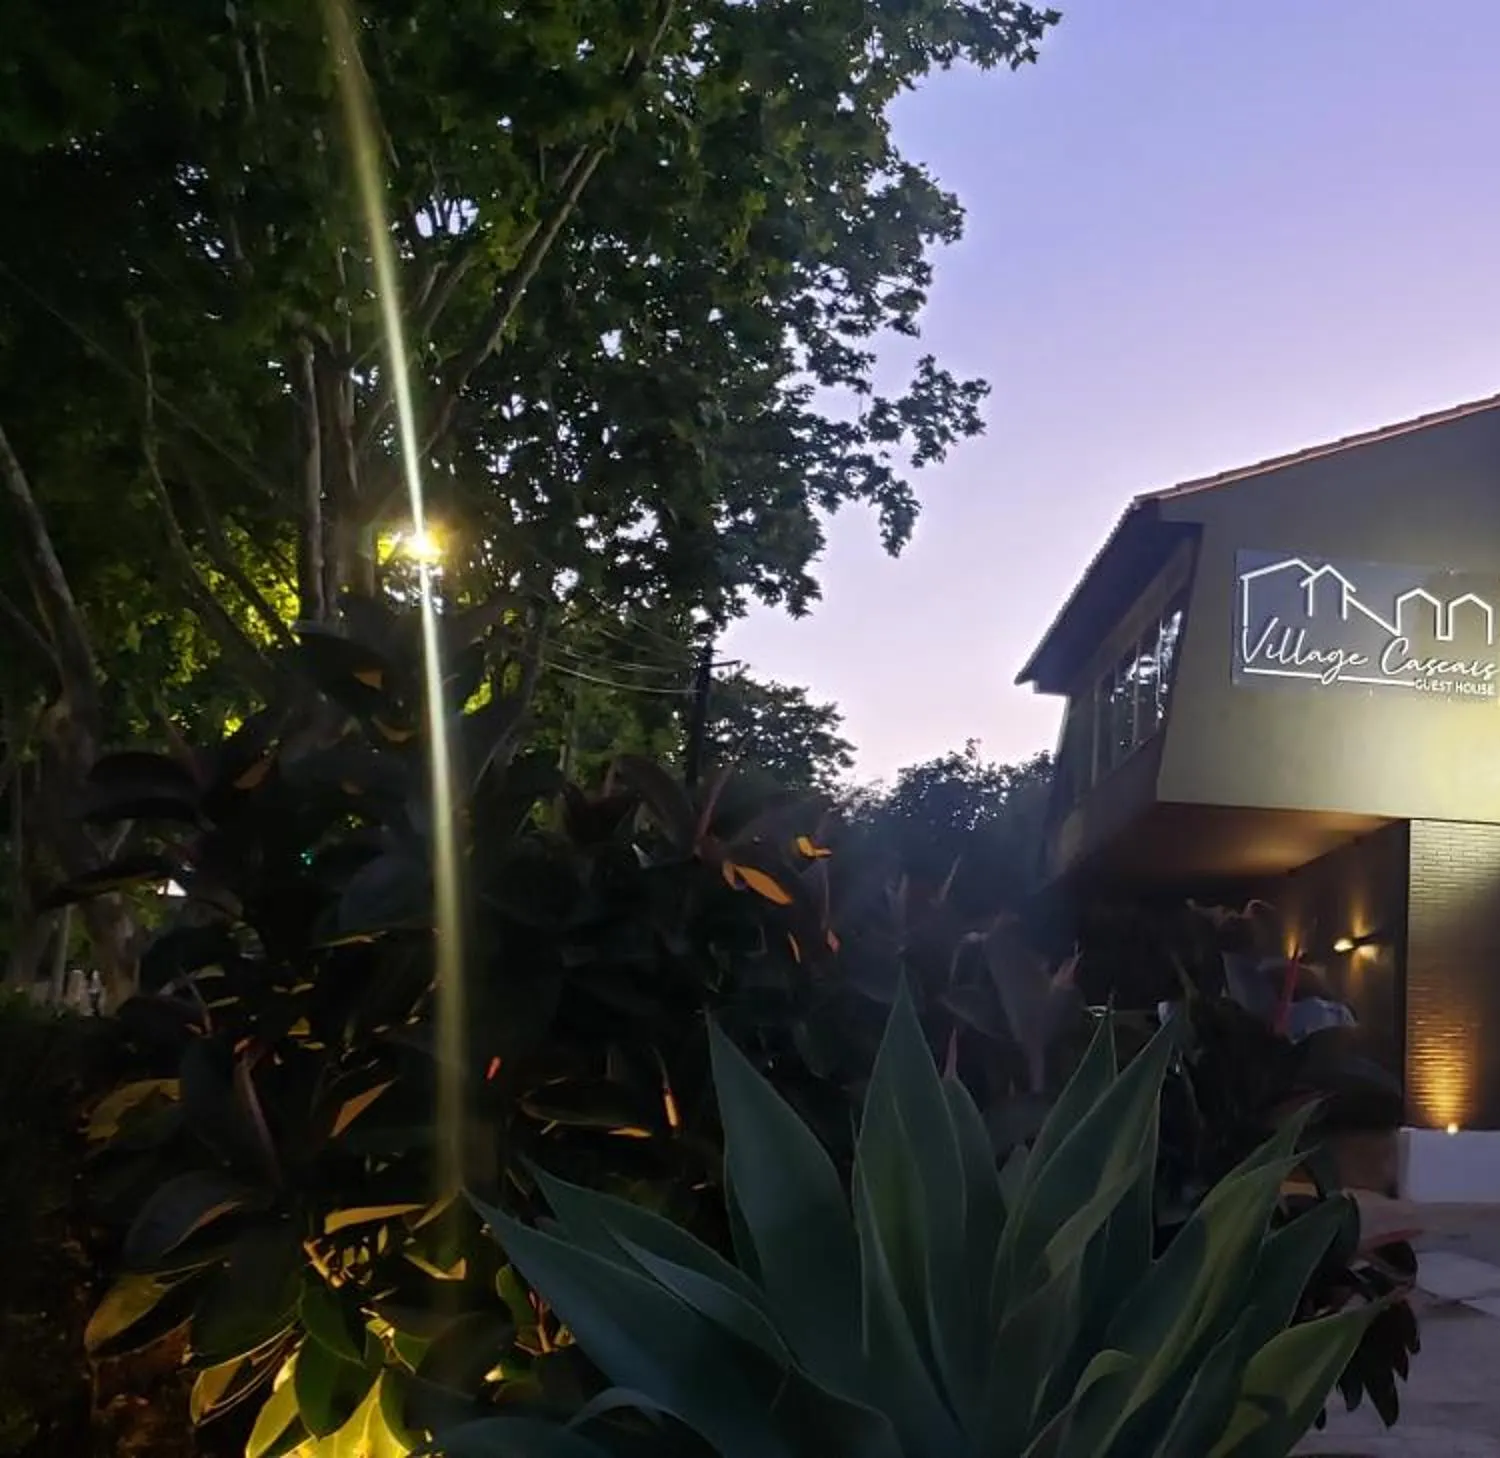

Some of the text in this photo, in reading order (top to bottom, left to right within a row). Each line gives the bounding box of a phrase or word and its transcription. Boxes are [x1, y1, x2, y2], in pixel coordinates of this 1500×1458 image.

[1242, 617, 1500, 684] Village Cascais
[1415, 678, 1496, 696] GUEST HOUSE
